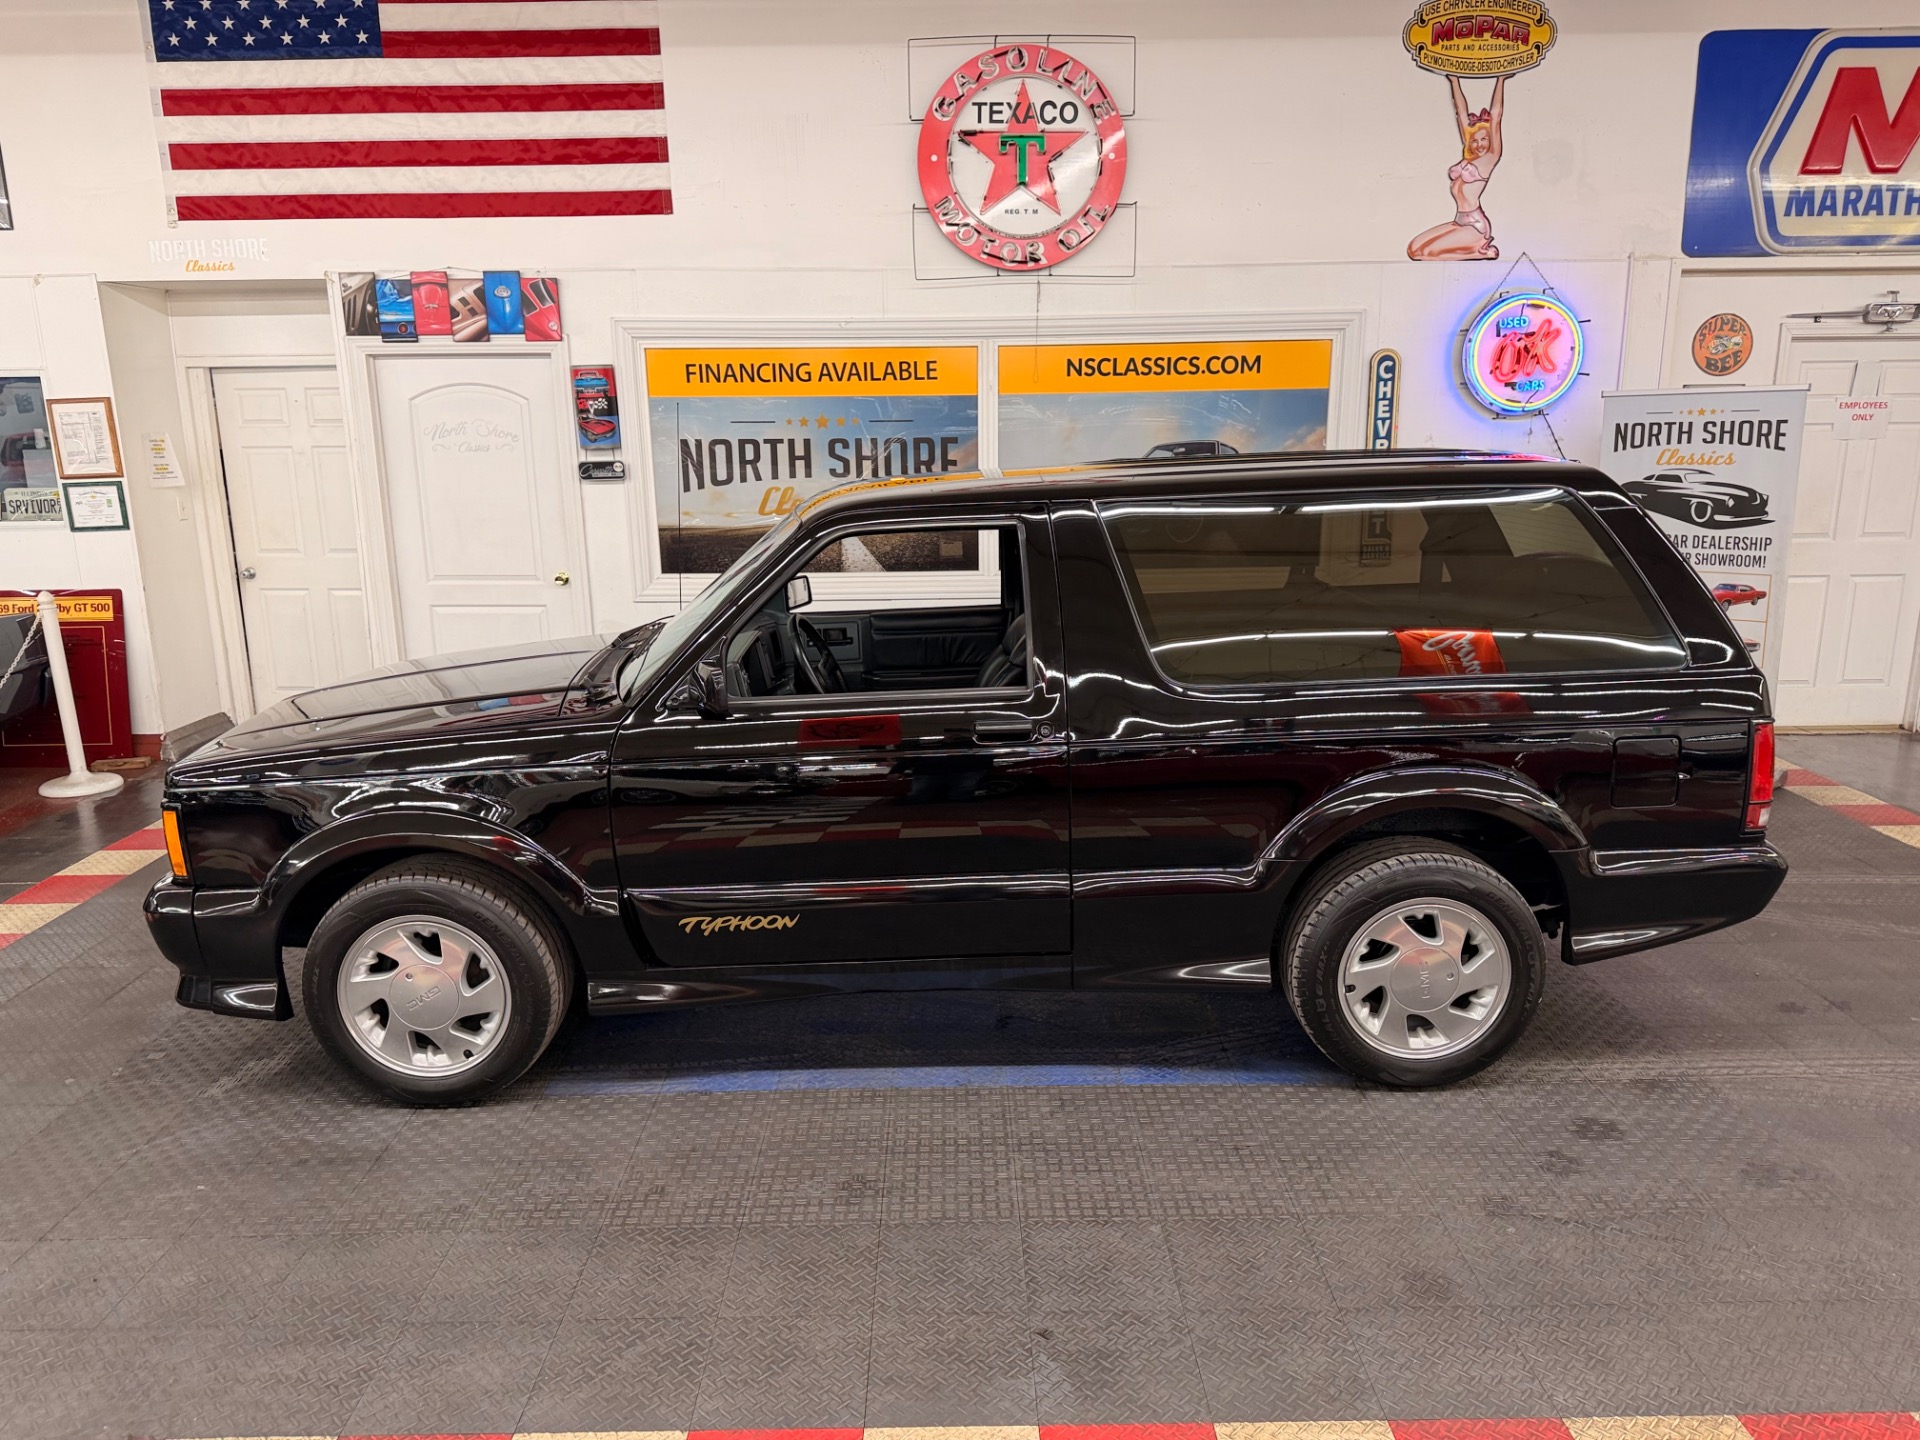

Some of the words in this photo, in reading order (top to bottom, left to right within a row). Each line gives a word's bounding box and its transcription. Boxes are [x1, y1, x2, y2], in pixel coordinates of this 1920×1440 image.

[1425, 4, 1441, 17] USE
[1443, 0, 1486, 12] CHRYSLER
[1488, 0, 1538, 16] ENGINEERED
[1441, 43, 1460, 51] PARTS
[1463, 43, 1475, 51] AND
[1478, 43, 1520, 51] ACCESSORIES
[932, 46, 1117, 126] GASOLINE
[972, 100, 1079, 125] TEXACO
[999, 134, 1047, 187] T
[934, 196, 1049, 267] MOTOR
[1058, 204, 1113, 252] OIL
[148, 239, 207, 263] NORTH
[211, 238, 271, 262] SHORE
[185, 259, 236, 273] Classics
[1498, 316, 1529, 328] USED
[1698, 315, 1747, 351] SUPER
[685, 362, 812, 384] FINANCING
[818, 360, 939, 382] AVAILABLE
[1066, 355, 1262, 377] NSCLASSICS.COM
[1704, 350, 1743, 373] BEE
[1516, 379, 1545, 391] CARS
[1839, 401, 1888, 409] EMPLOYEES
[1851, 413, 1875, 421] ONLY
[423, 420, 468, 441] North
[471, 418, 520, 442] Shore
[1613, 421, 1693, 452] NORTH
[1701, 419, 1789, 451] SHORE
[679, 438, 812, 493] NORTH
[1655, 448, 1736, 466] Classics
[8, 499, 57, 514] SRVIVOR
[1692, 535, 1772, 551] DEALERSHIP
[1694, 553, 1767, 568] SHOWROOM!
[12, 604, 35, 613] Ford
[74, 603, 88, 613] GT
[90, 603, 110, 612] 500
[678, 913, 800, 937] TYPHOON
[406, 986, 441, 1011] GMC
